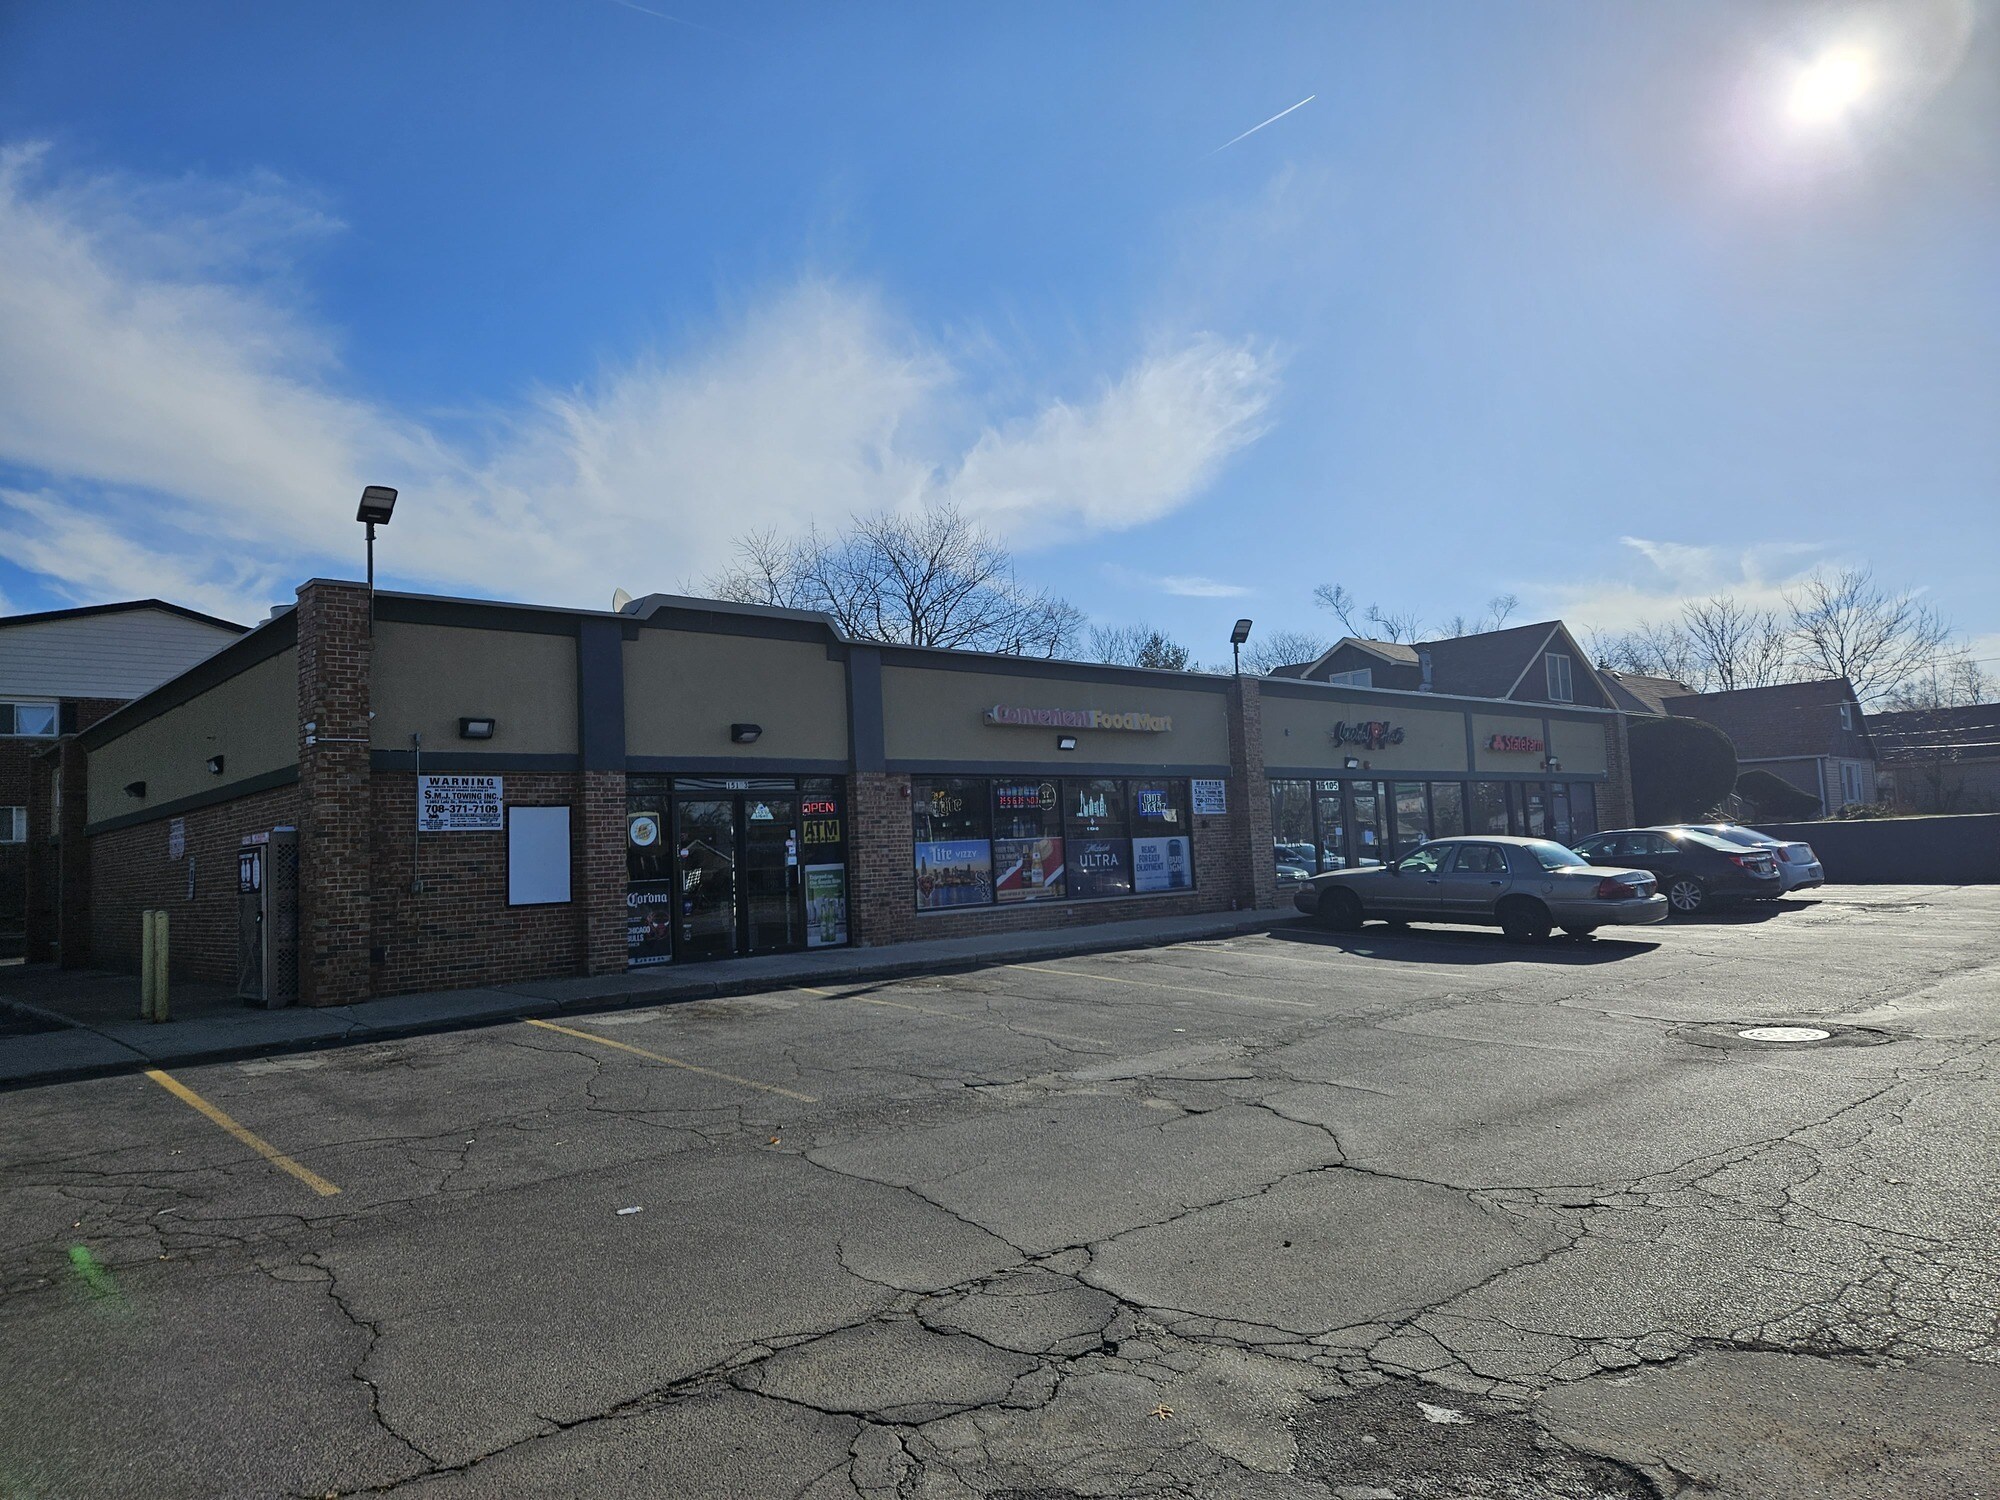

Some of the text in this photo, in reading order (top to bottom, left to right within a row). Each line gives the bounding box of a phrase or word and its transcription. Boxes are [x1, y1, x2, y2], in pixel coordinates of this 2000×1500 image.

[993, 704, 1173, 732] Convenient Food Mart
[429, 777, 494, 786] WARNING
[1316, 781, 1338, 790] 15105
[424, 790, 451, 800] S.M.J.
[452, 792, 482, 800] TOWING
[1143, 793, 1162, 803] BUD
[425, 804, 498, 813] 708-371-7109
[802, 802, 835, 814] OPEN
[1141, 802, 1167, 813] LIGHT
[804, 820, 838, 838] ATM
[1141, 845, 1157, 854] REACH
[931, 846, 977, 864] Lite VIZZY
[1138, 853, 1160, 863] FOR EASY
[1168, 855, 1183, 864] BUD
[1079, 853, 1119, 868] ULTRA
[1136, 862, 1164, 872] ENJOYMENT
[627, 892, 668, 908] Corona
